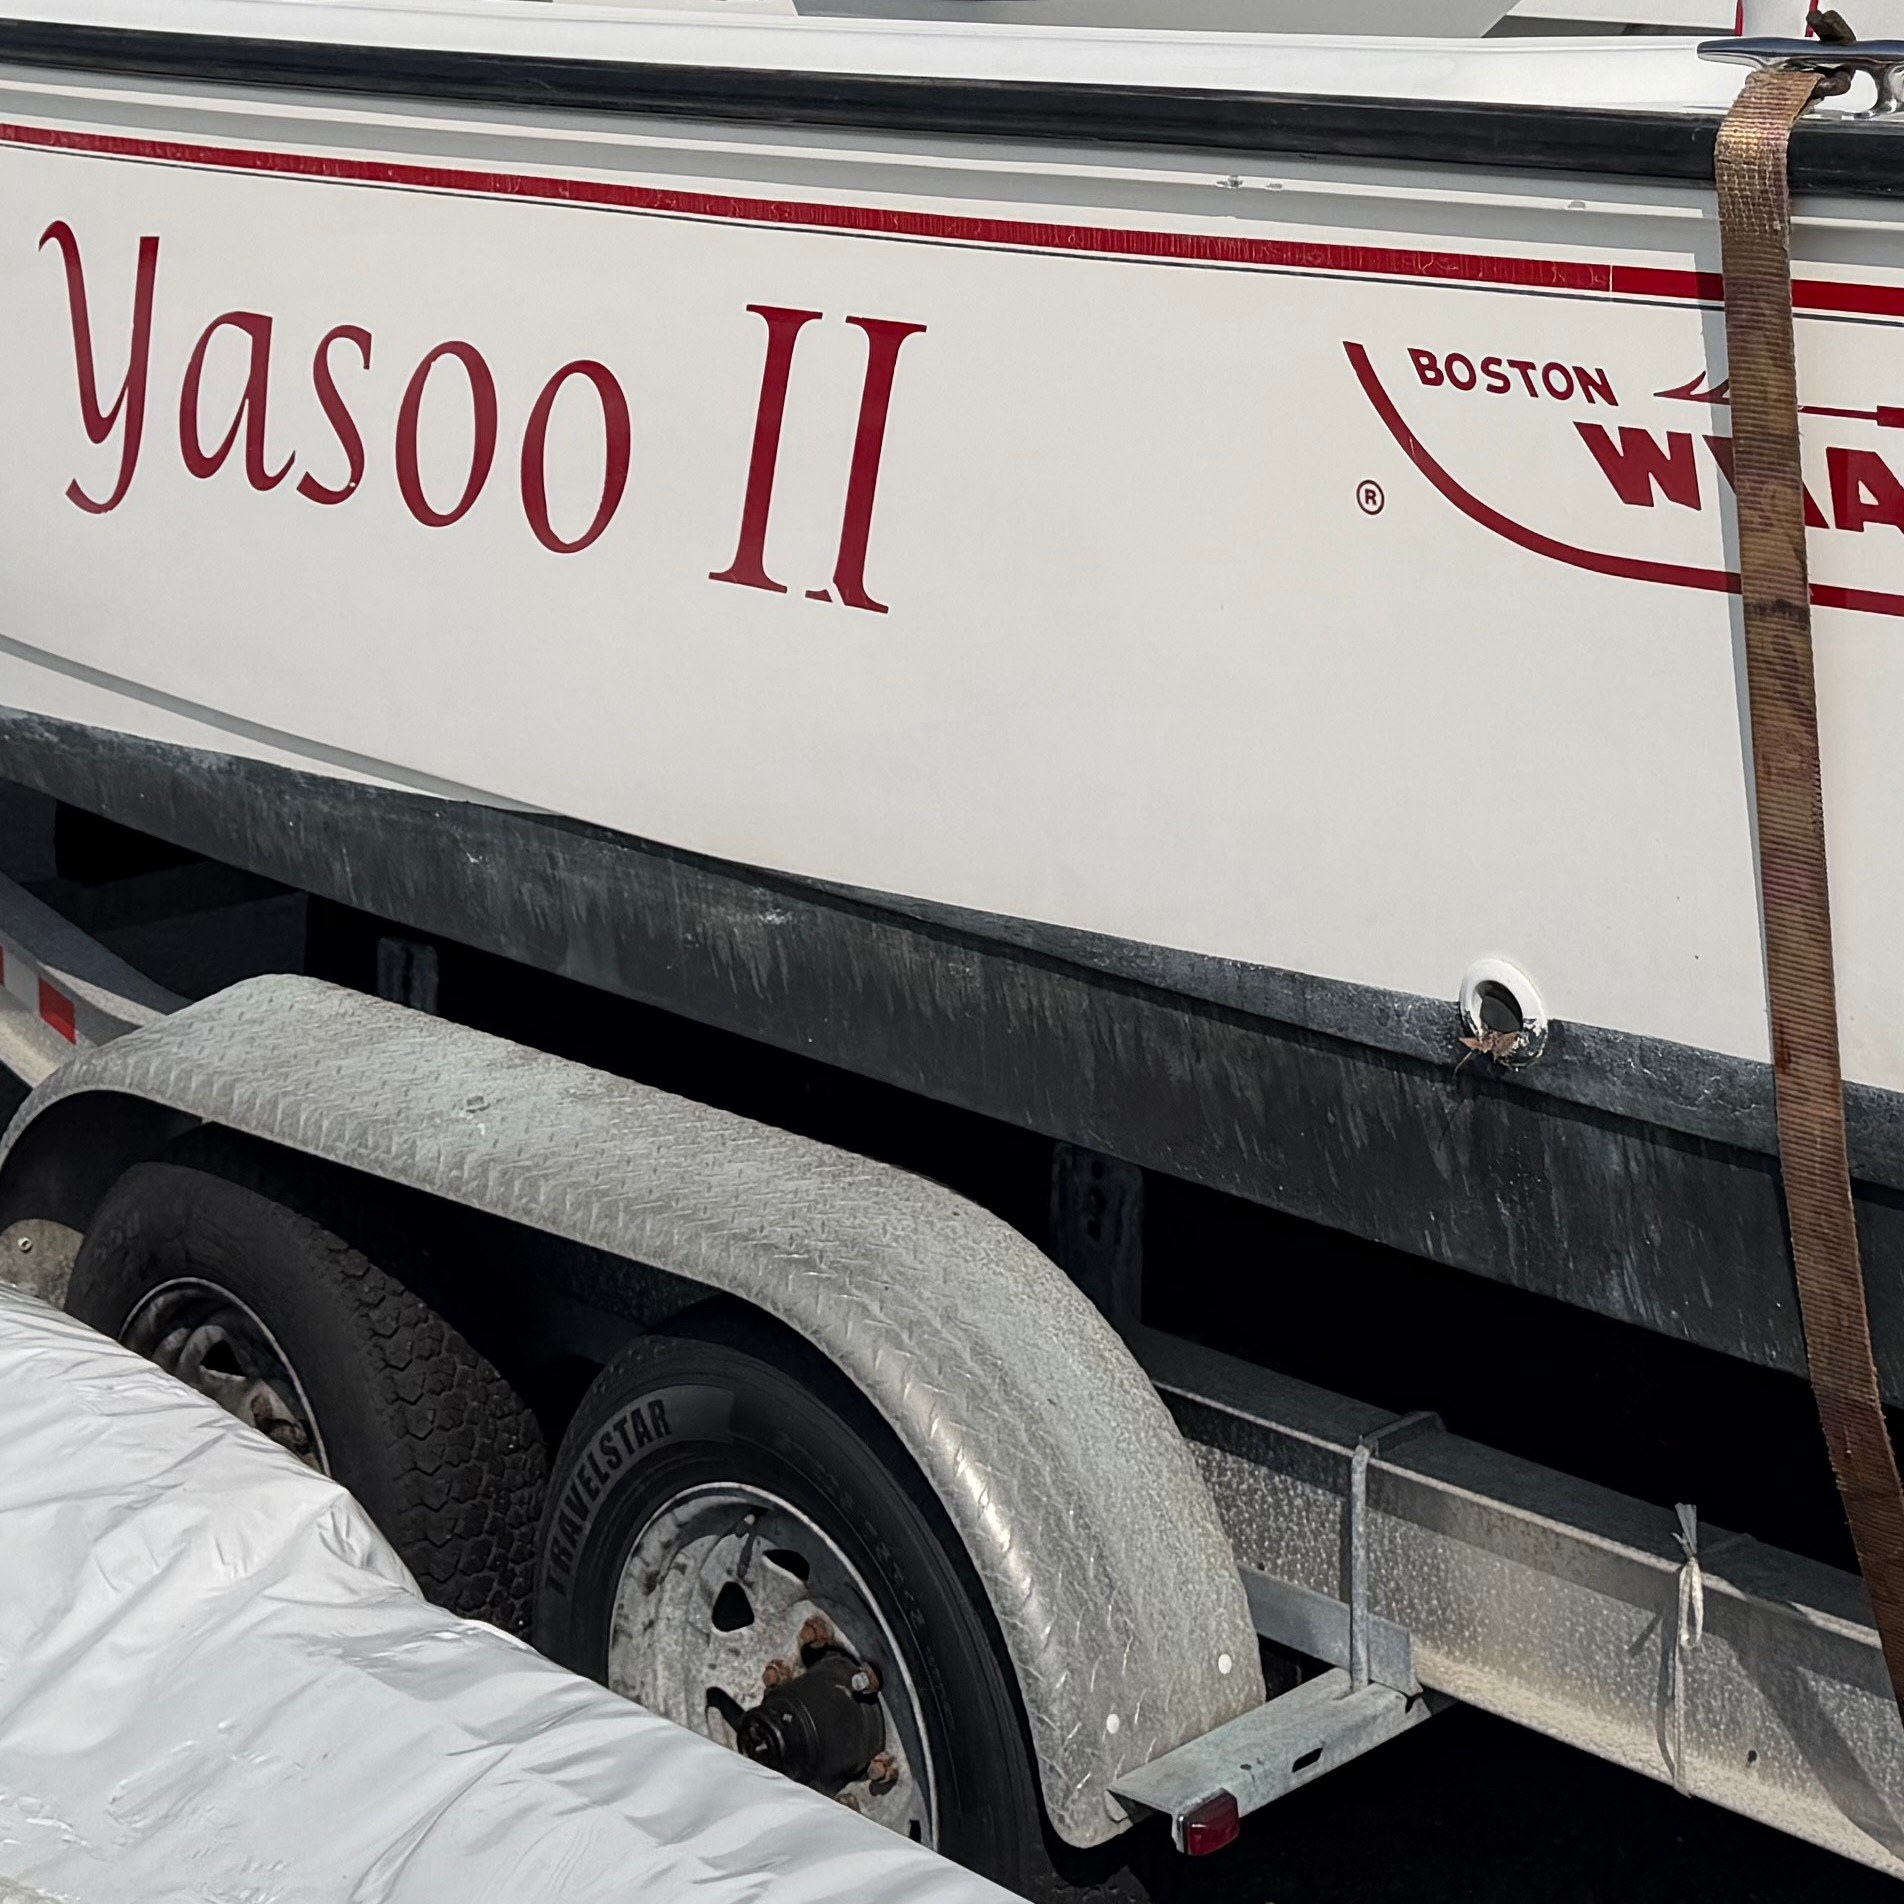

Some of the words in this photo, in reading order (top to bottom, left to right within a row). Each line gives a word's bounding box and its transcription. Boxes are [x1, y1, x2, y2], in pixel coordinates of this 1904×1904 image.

[39, 220, 632, 554] Yasoo
[708, 304, 927, 614] II
[1409, 348, 1618, 407] BOSTON
[543, 1398, 673, 1596] TRAVELSTAR
